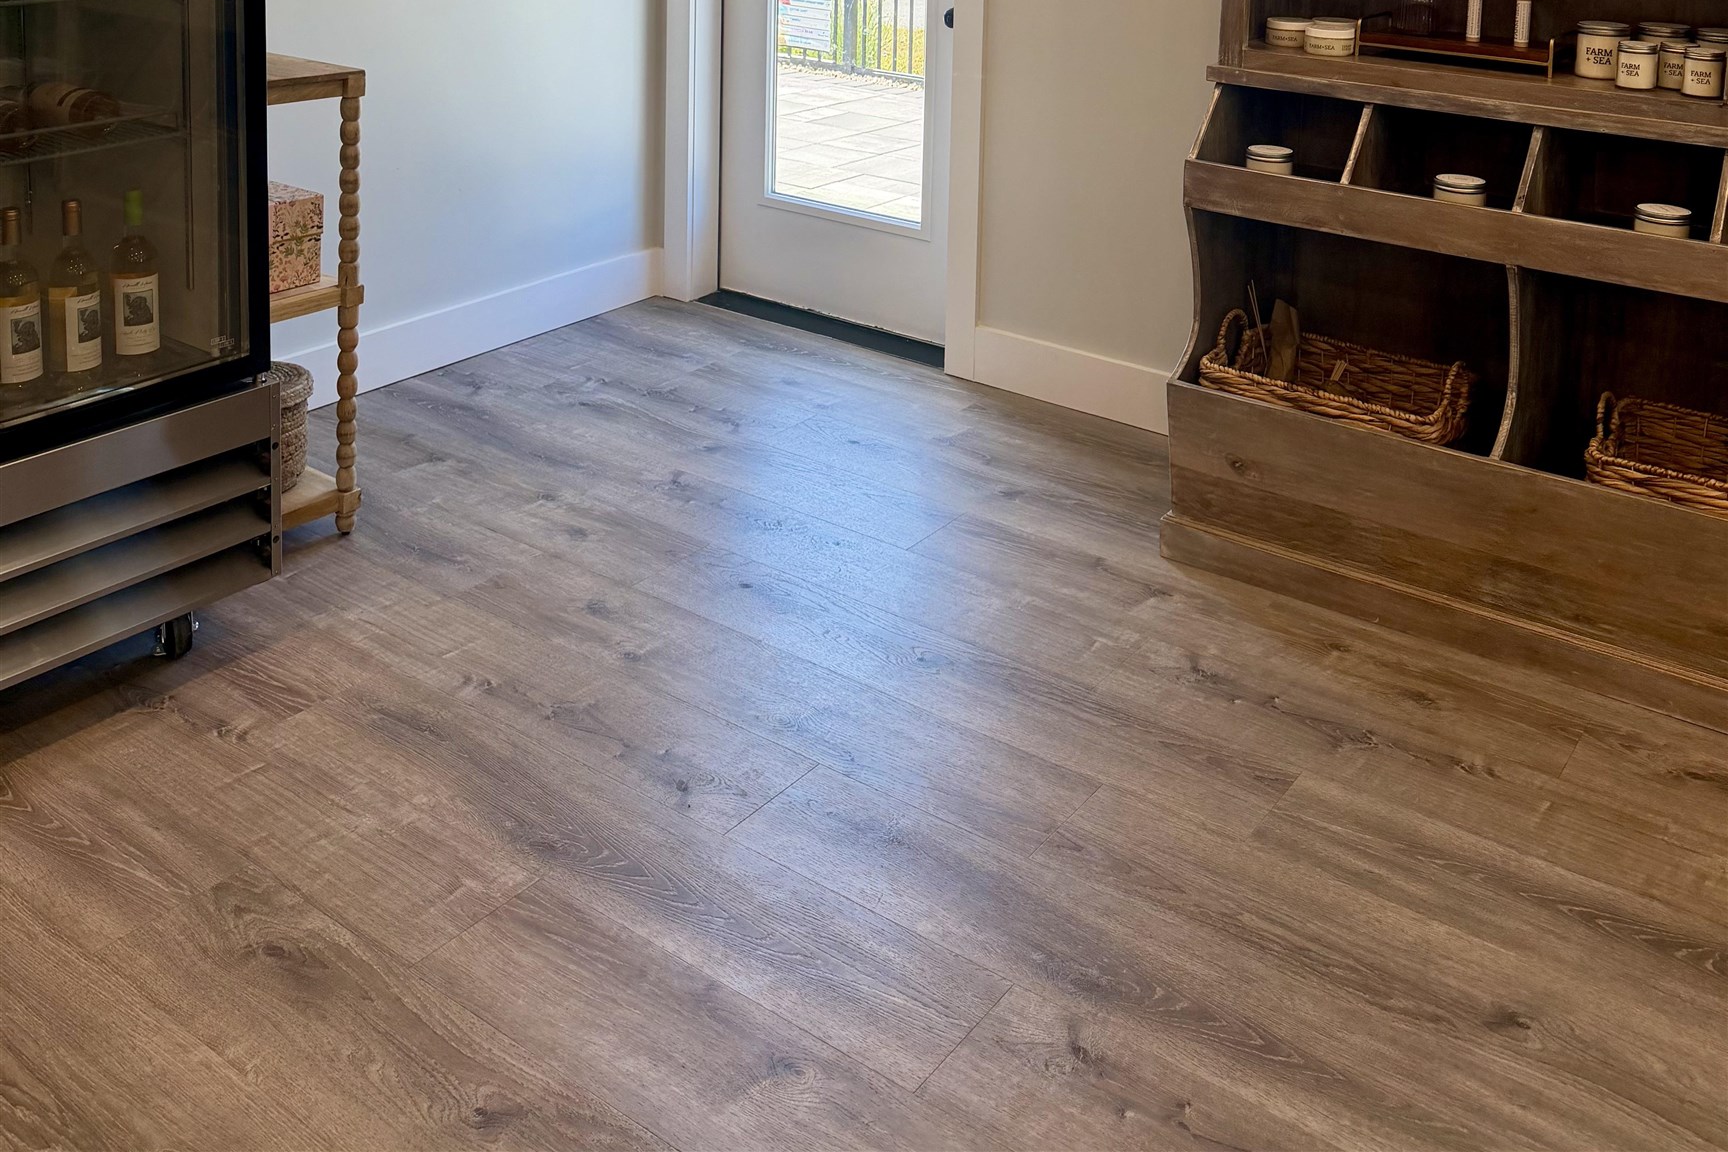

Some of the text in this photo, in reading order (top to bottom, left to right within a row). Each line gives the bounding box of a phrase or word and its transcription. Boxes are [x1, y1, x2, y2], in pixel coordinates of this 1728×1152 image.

[1585, 47, 1613, 57] FARM
[1592, 56, 1612, 65] SEA
[1621, 62, 1640, 70] FARM
[1664, 62, 1684, 70] FARM
[1625, 69, 1640, 77] SEA
[1669, 69, 1683, 77] SEA
[1690, 70, 1712, 78] FARM
[1696, 77, 1711, 85] SEA
